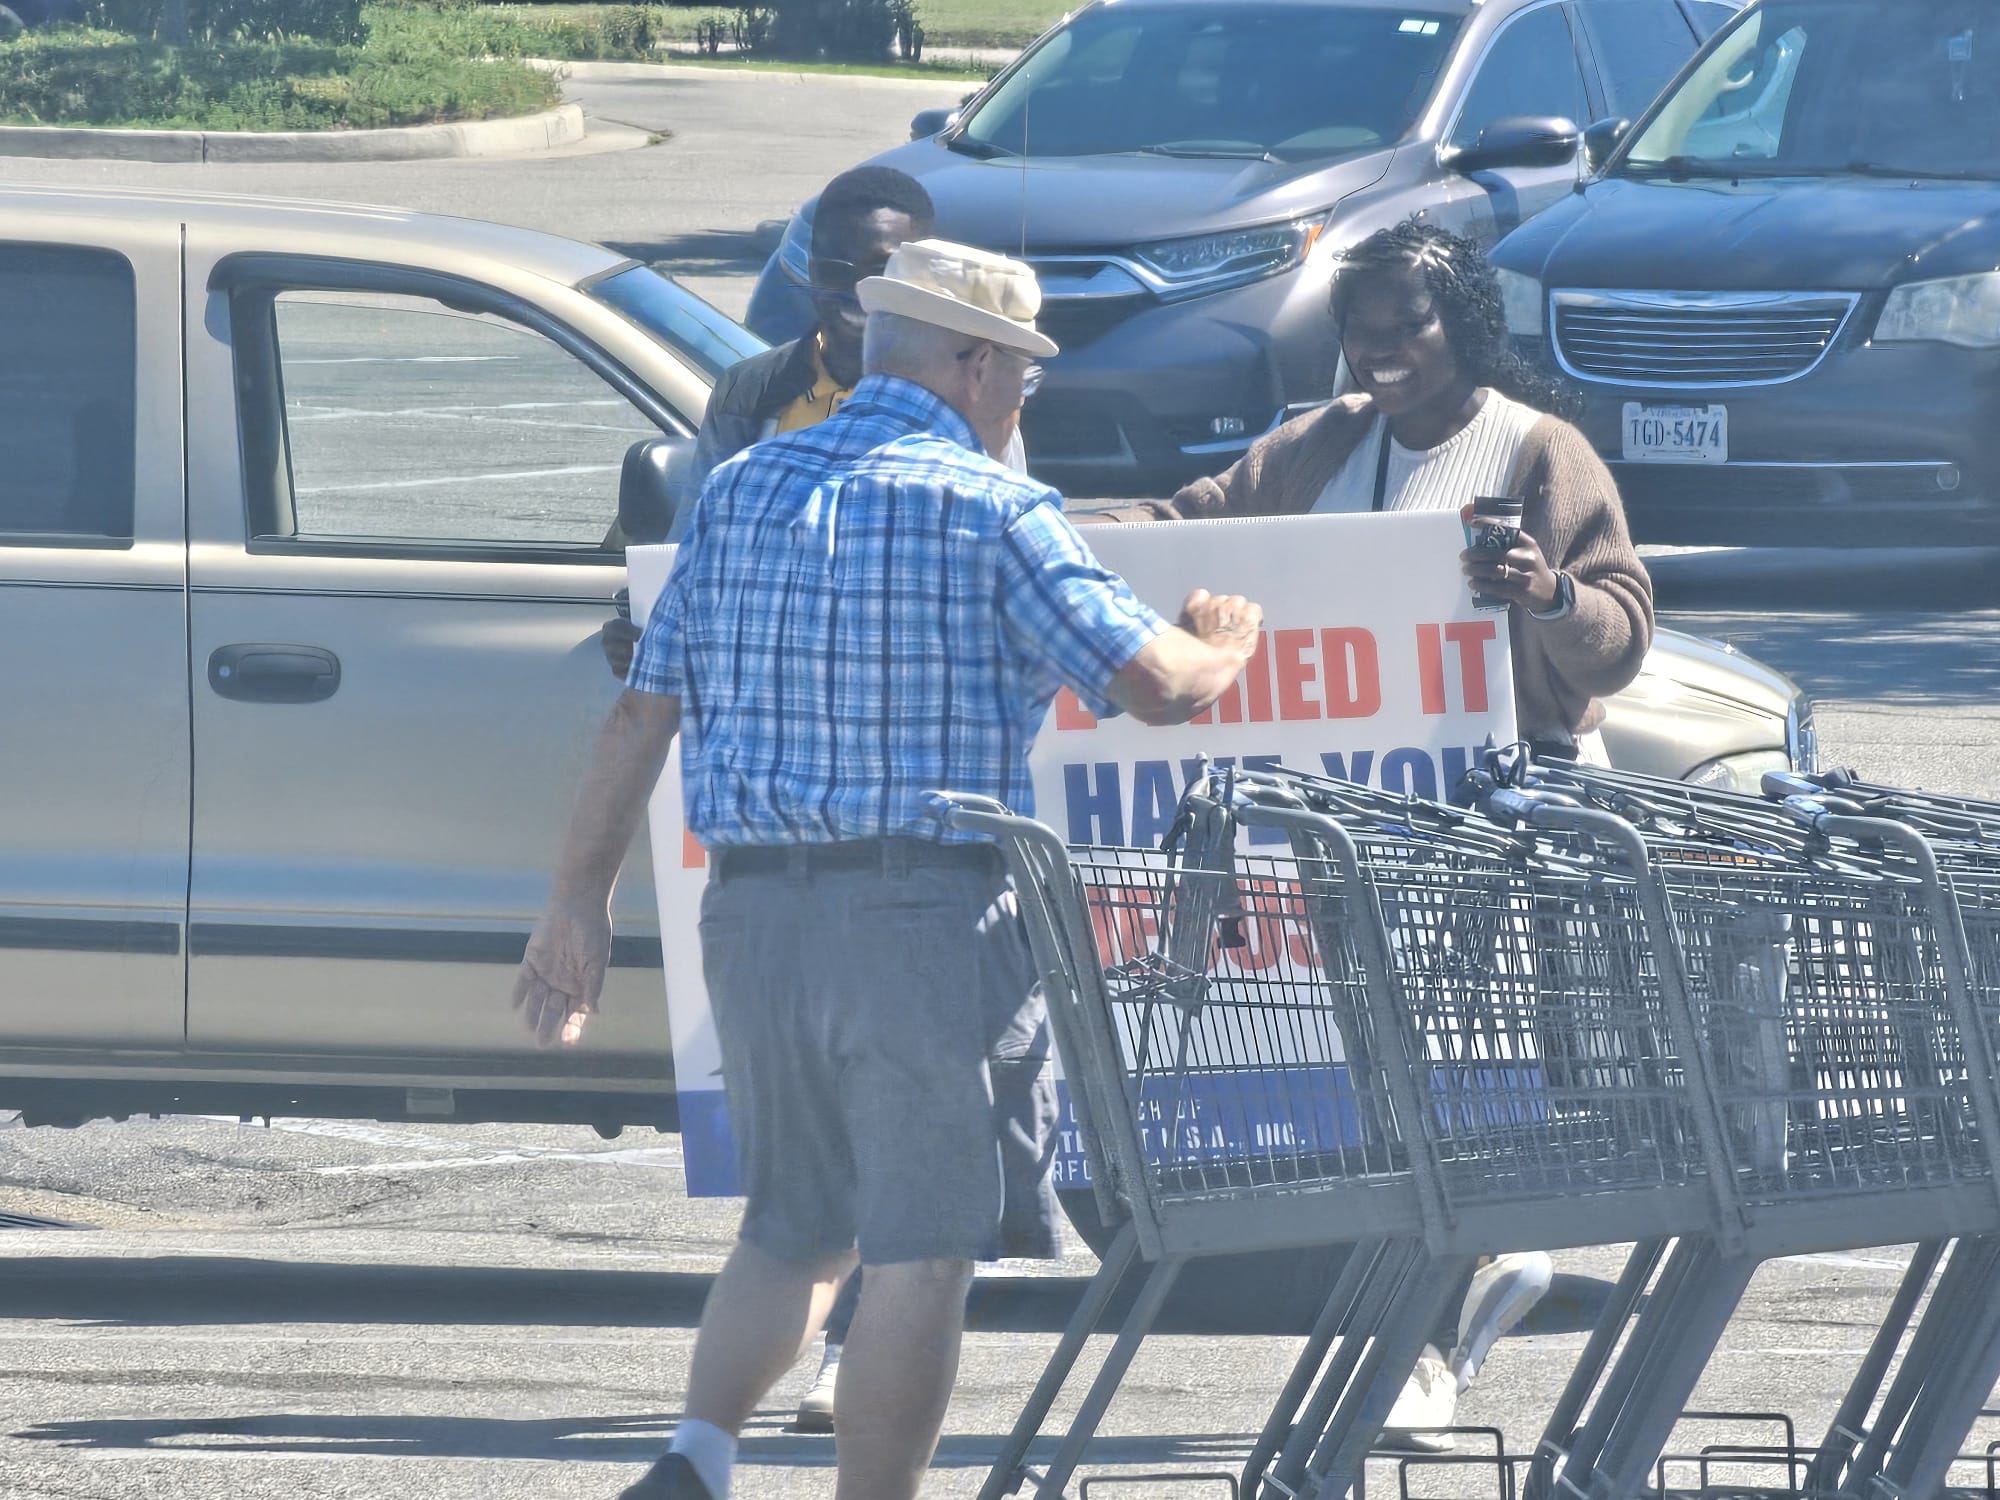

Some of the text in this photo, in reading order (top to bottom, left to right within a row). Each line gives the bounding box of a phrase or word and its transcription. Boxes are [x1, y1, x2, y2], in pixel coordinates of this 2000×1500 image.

[1416, 620, 1496, 714] IT
[1063, 755, 1291, 848] HA
[1086, 880, 1324, 973] EUS
